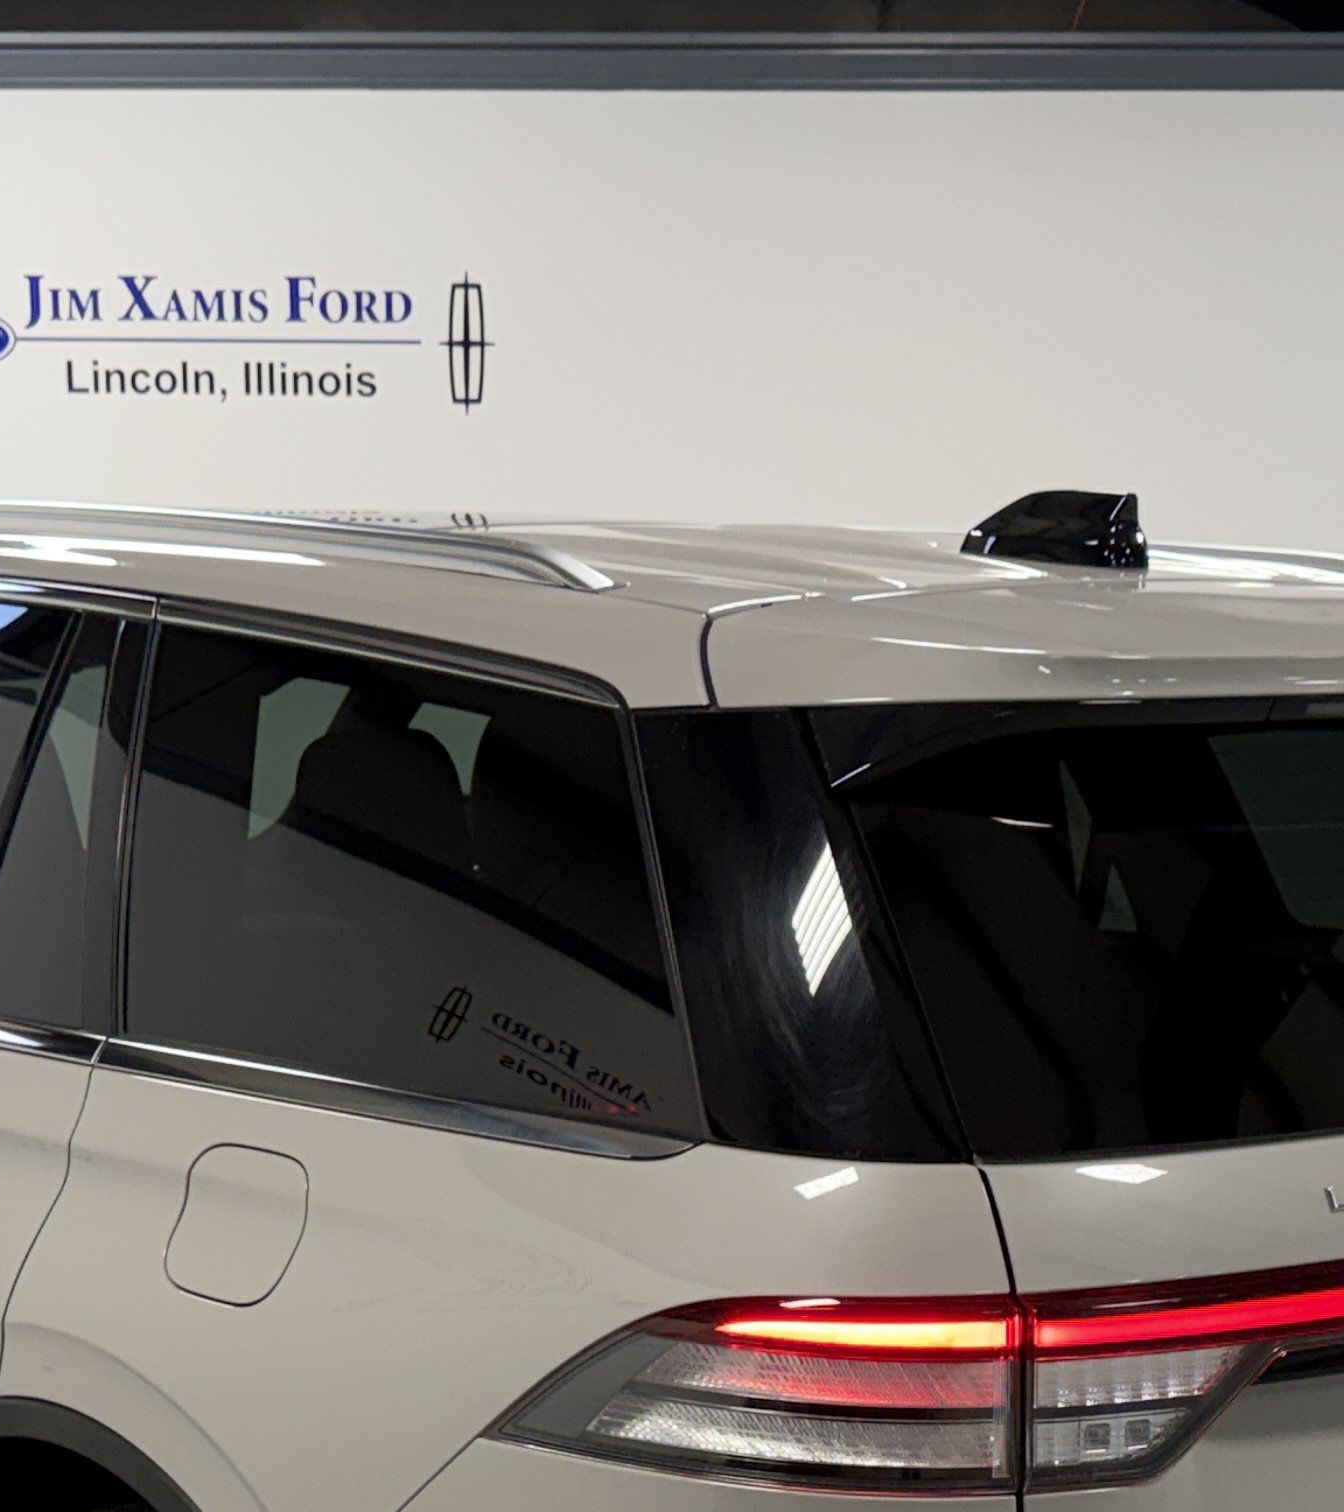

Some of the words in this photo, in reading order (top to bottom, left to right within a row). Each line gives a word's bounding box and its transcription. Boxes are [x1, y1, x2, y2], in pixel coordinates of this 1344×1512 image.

[25, 275, 101, 330] JIM
[118, 276, 269, 323] XAMIS
[286, 276, 413, 324] FORD
[65, 360, 228, 402] Lincoln,
[243, 361, 378, 398] Illinois
